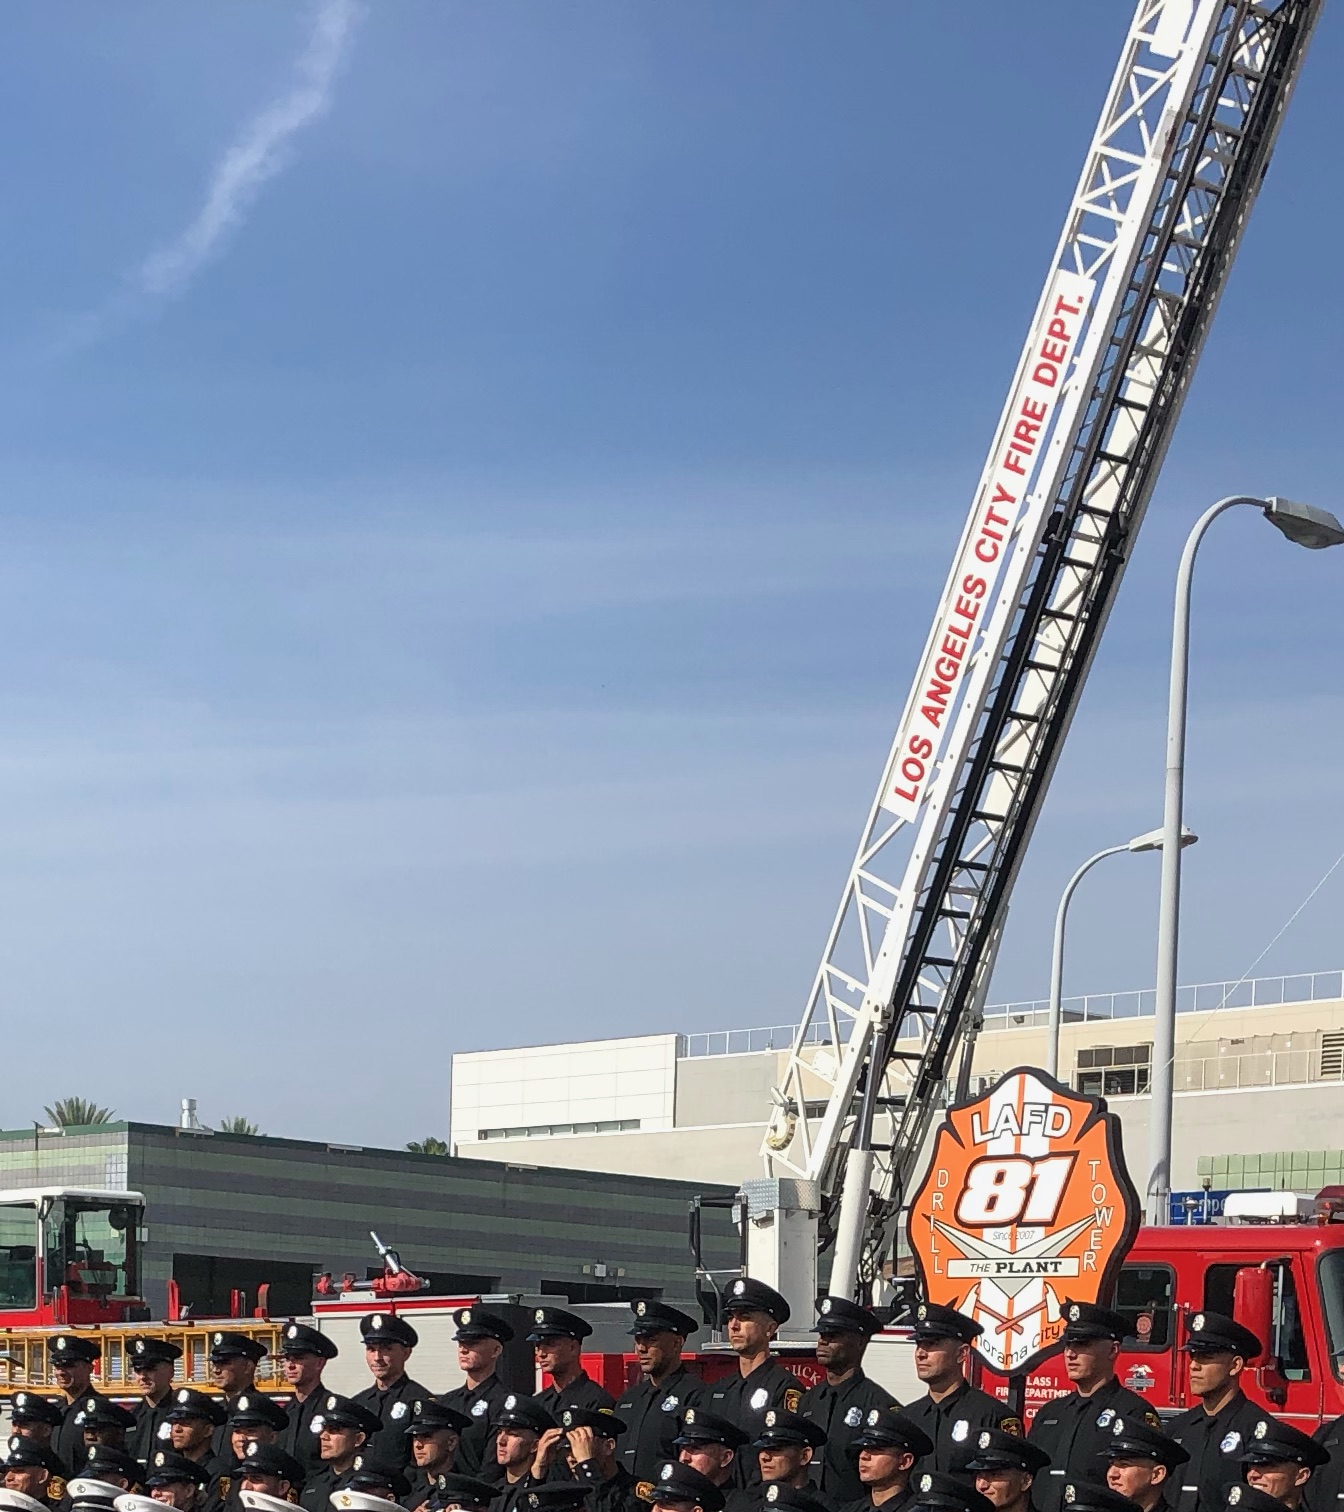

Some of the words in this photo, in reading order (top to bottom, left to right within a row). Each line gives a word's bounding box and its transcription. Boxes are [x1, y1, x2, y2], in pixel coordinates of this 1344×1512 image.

[894, 733, 934, 803] LOS
[921, 573, 987, 729] ANGELES
[975, 482, 1019, 565] CITY
[1003, 395, 1049, 477] FIRE
[1032, 293, 1087, 389] DEPT.
[971, 1102, 1072, 1145] LAFD
[956, 1151, 1079, 1227] 81
[930, 1168, 950, 1275] DRILL
[1082, 1160, 1113, 1272] TOWER
[970, 1263, 991, 1274] THE
[994, 1261, 1062, 1274] PLANT
[975, 1334, 1028, 1365] norama
[790, 1363, 822, 1386] UCK
[995, 1386, 1010, 1397] FIR
[1024, 1387, 1072, 1399] EPARTME
[1025, 1376, 1052, 1387] LASS
